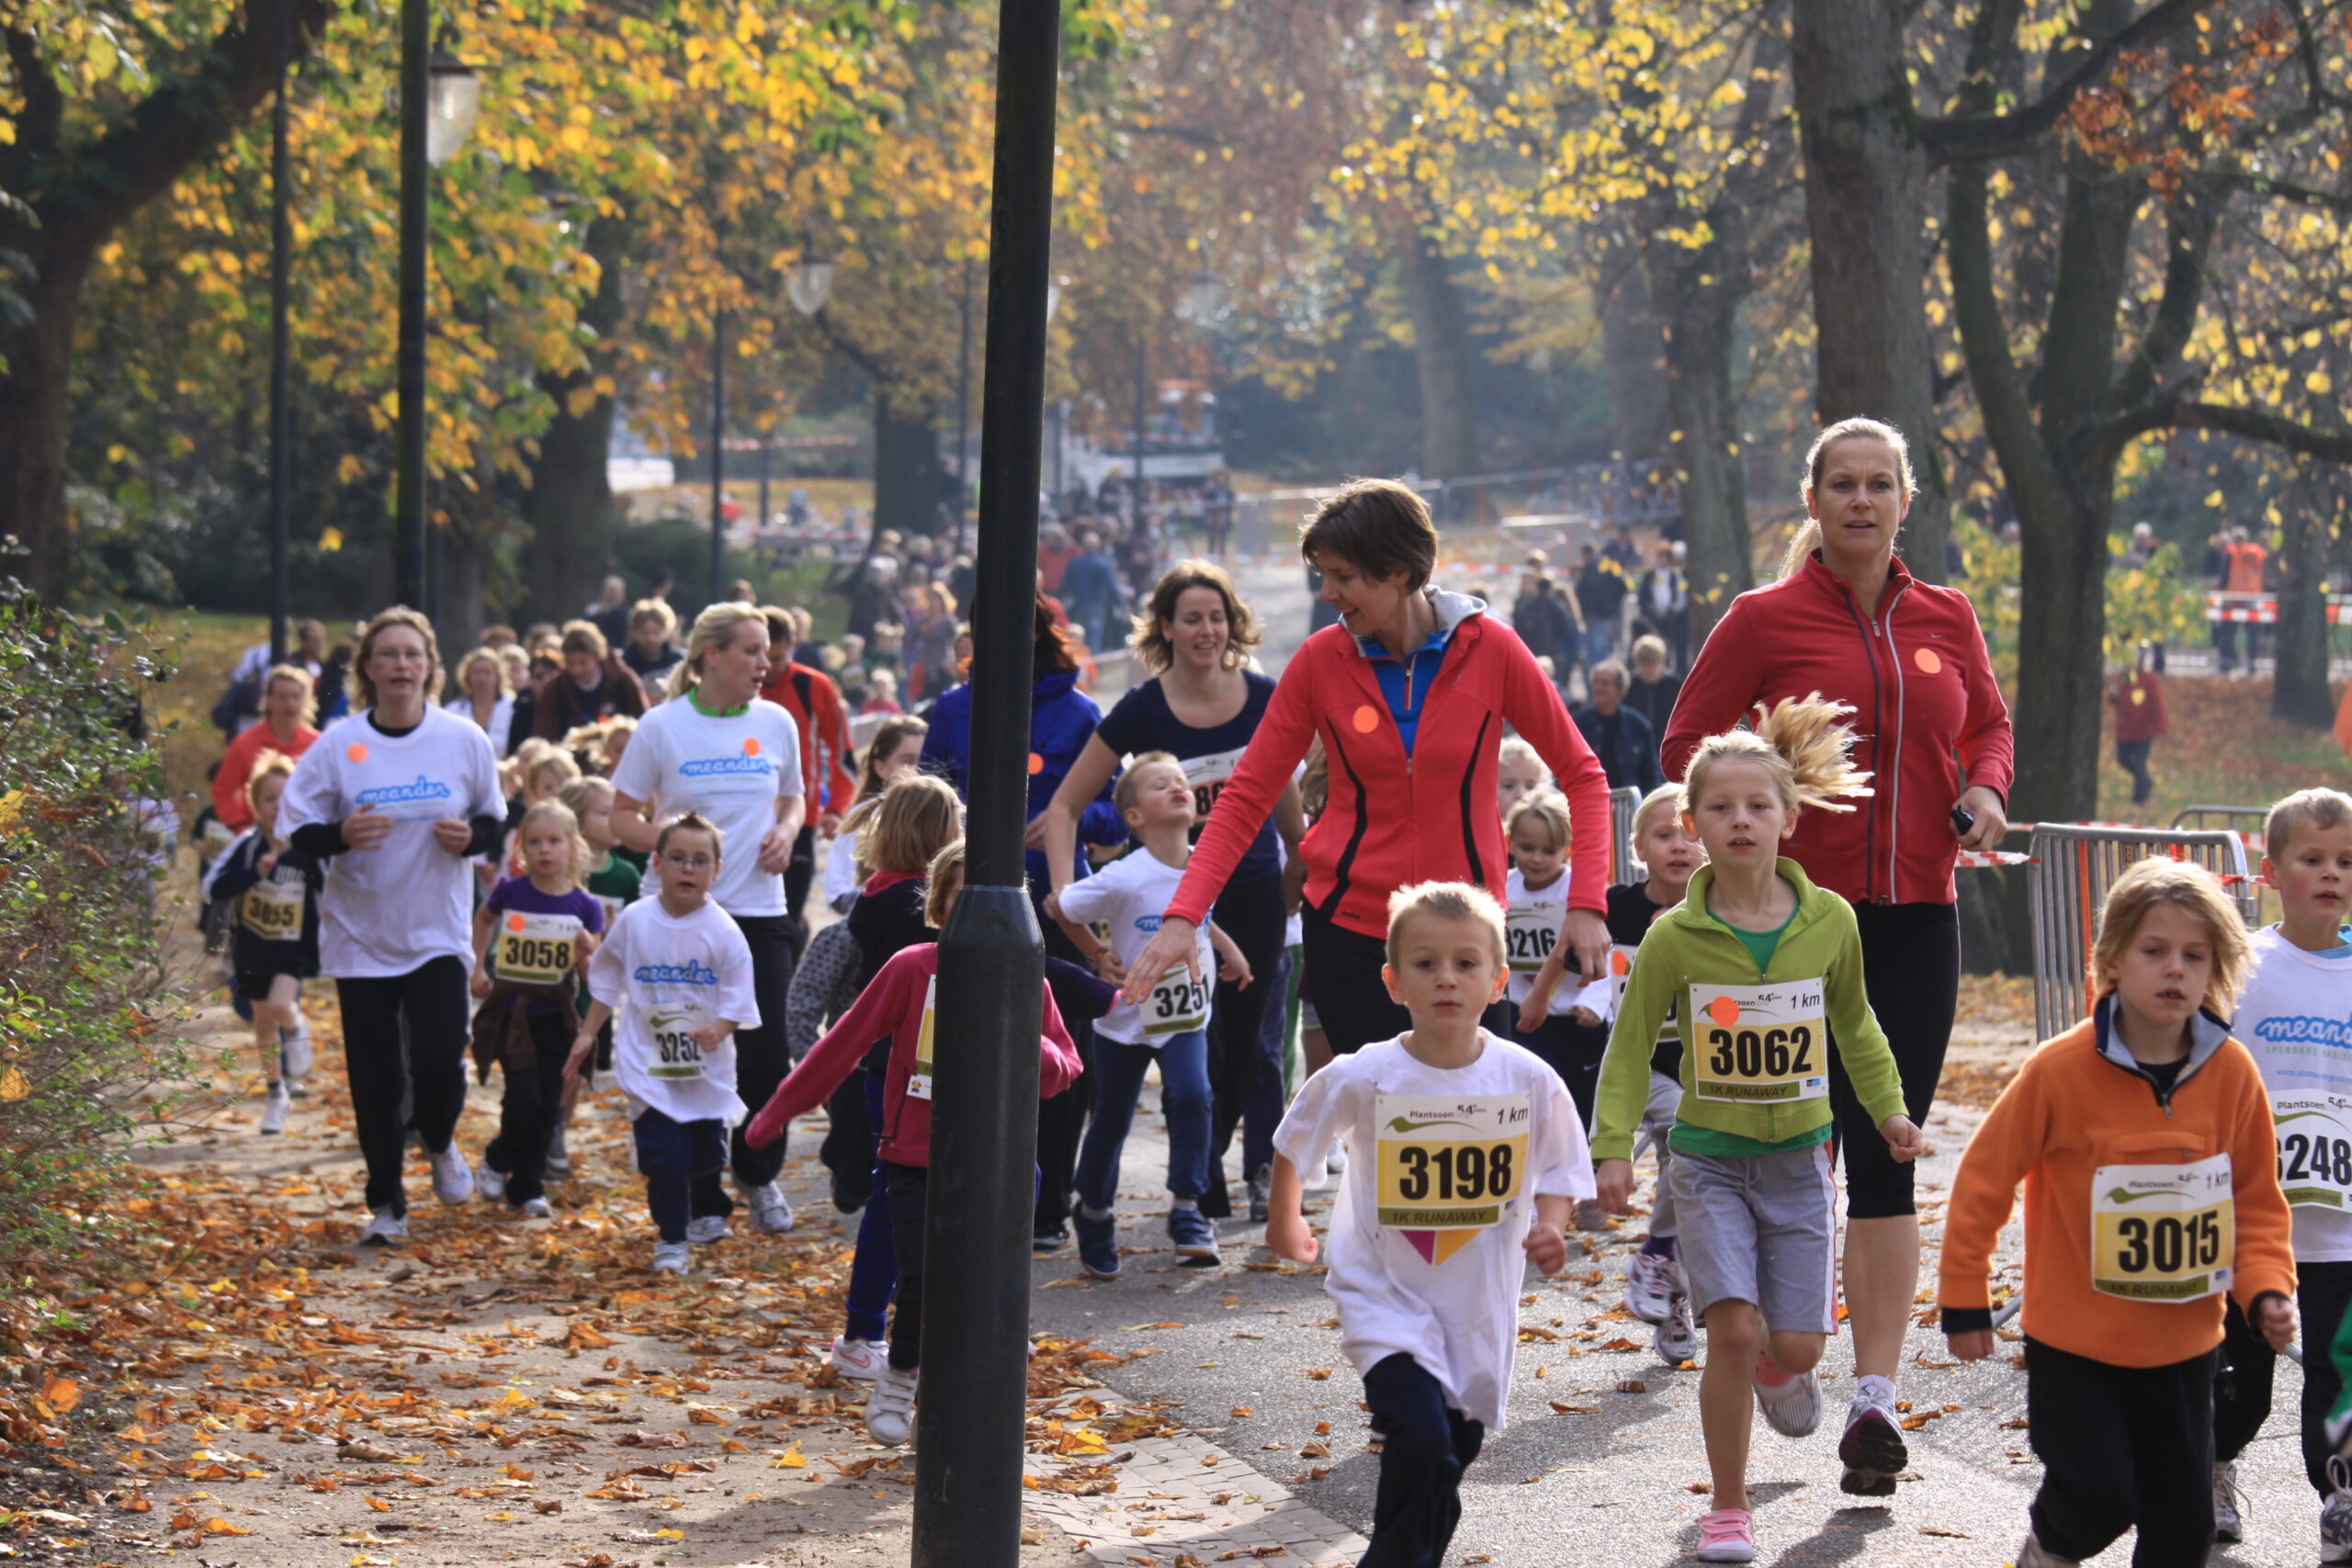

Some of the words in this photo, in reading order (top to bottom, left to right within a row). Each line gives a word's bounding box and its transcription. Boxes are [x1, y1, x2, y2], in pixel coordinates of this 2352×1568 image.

[680, 754, 773, 776] meander
[356, 776, 451, 803] meander
[505, 937, 570, 969] 3058
[634, 960, 718, 986] meander
[1791, 995, 1797, 1010] 1
[1802, 993, 1820, 1008] km
[1709, 1026, 1813, 1077] 3062
[1708, 1086, 1724, 1095] 1K
[1726, 1086, 1788, 1098] RUNAWAY
[1498, 1109, 1504, 1124] 1
[1509, 1106, 1528, 1122] km
[1399, 1144, 1512, 1200] 3198
[1391, 1212, 1408, 1223] 1K
[1414, 1211, 1487, 1224] RUNAWAY
[2118, 1210, 2219, 1273] 3015
